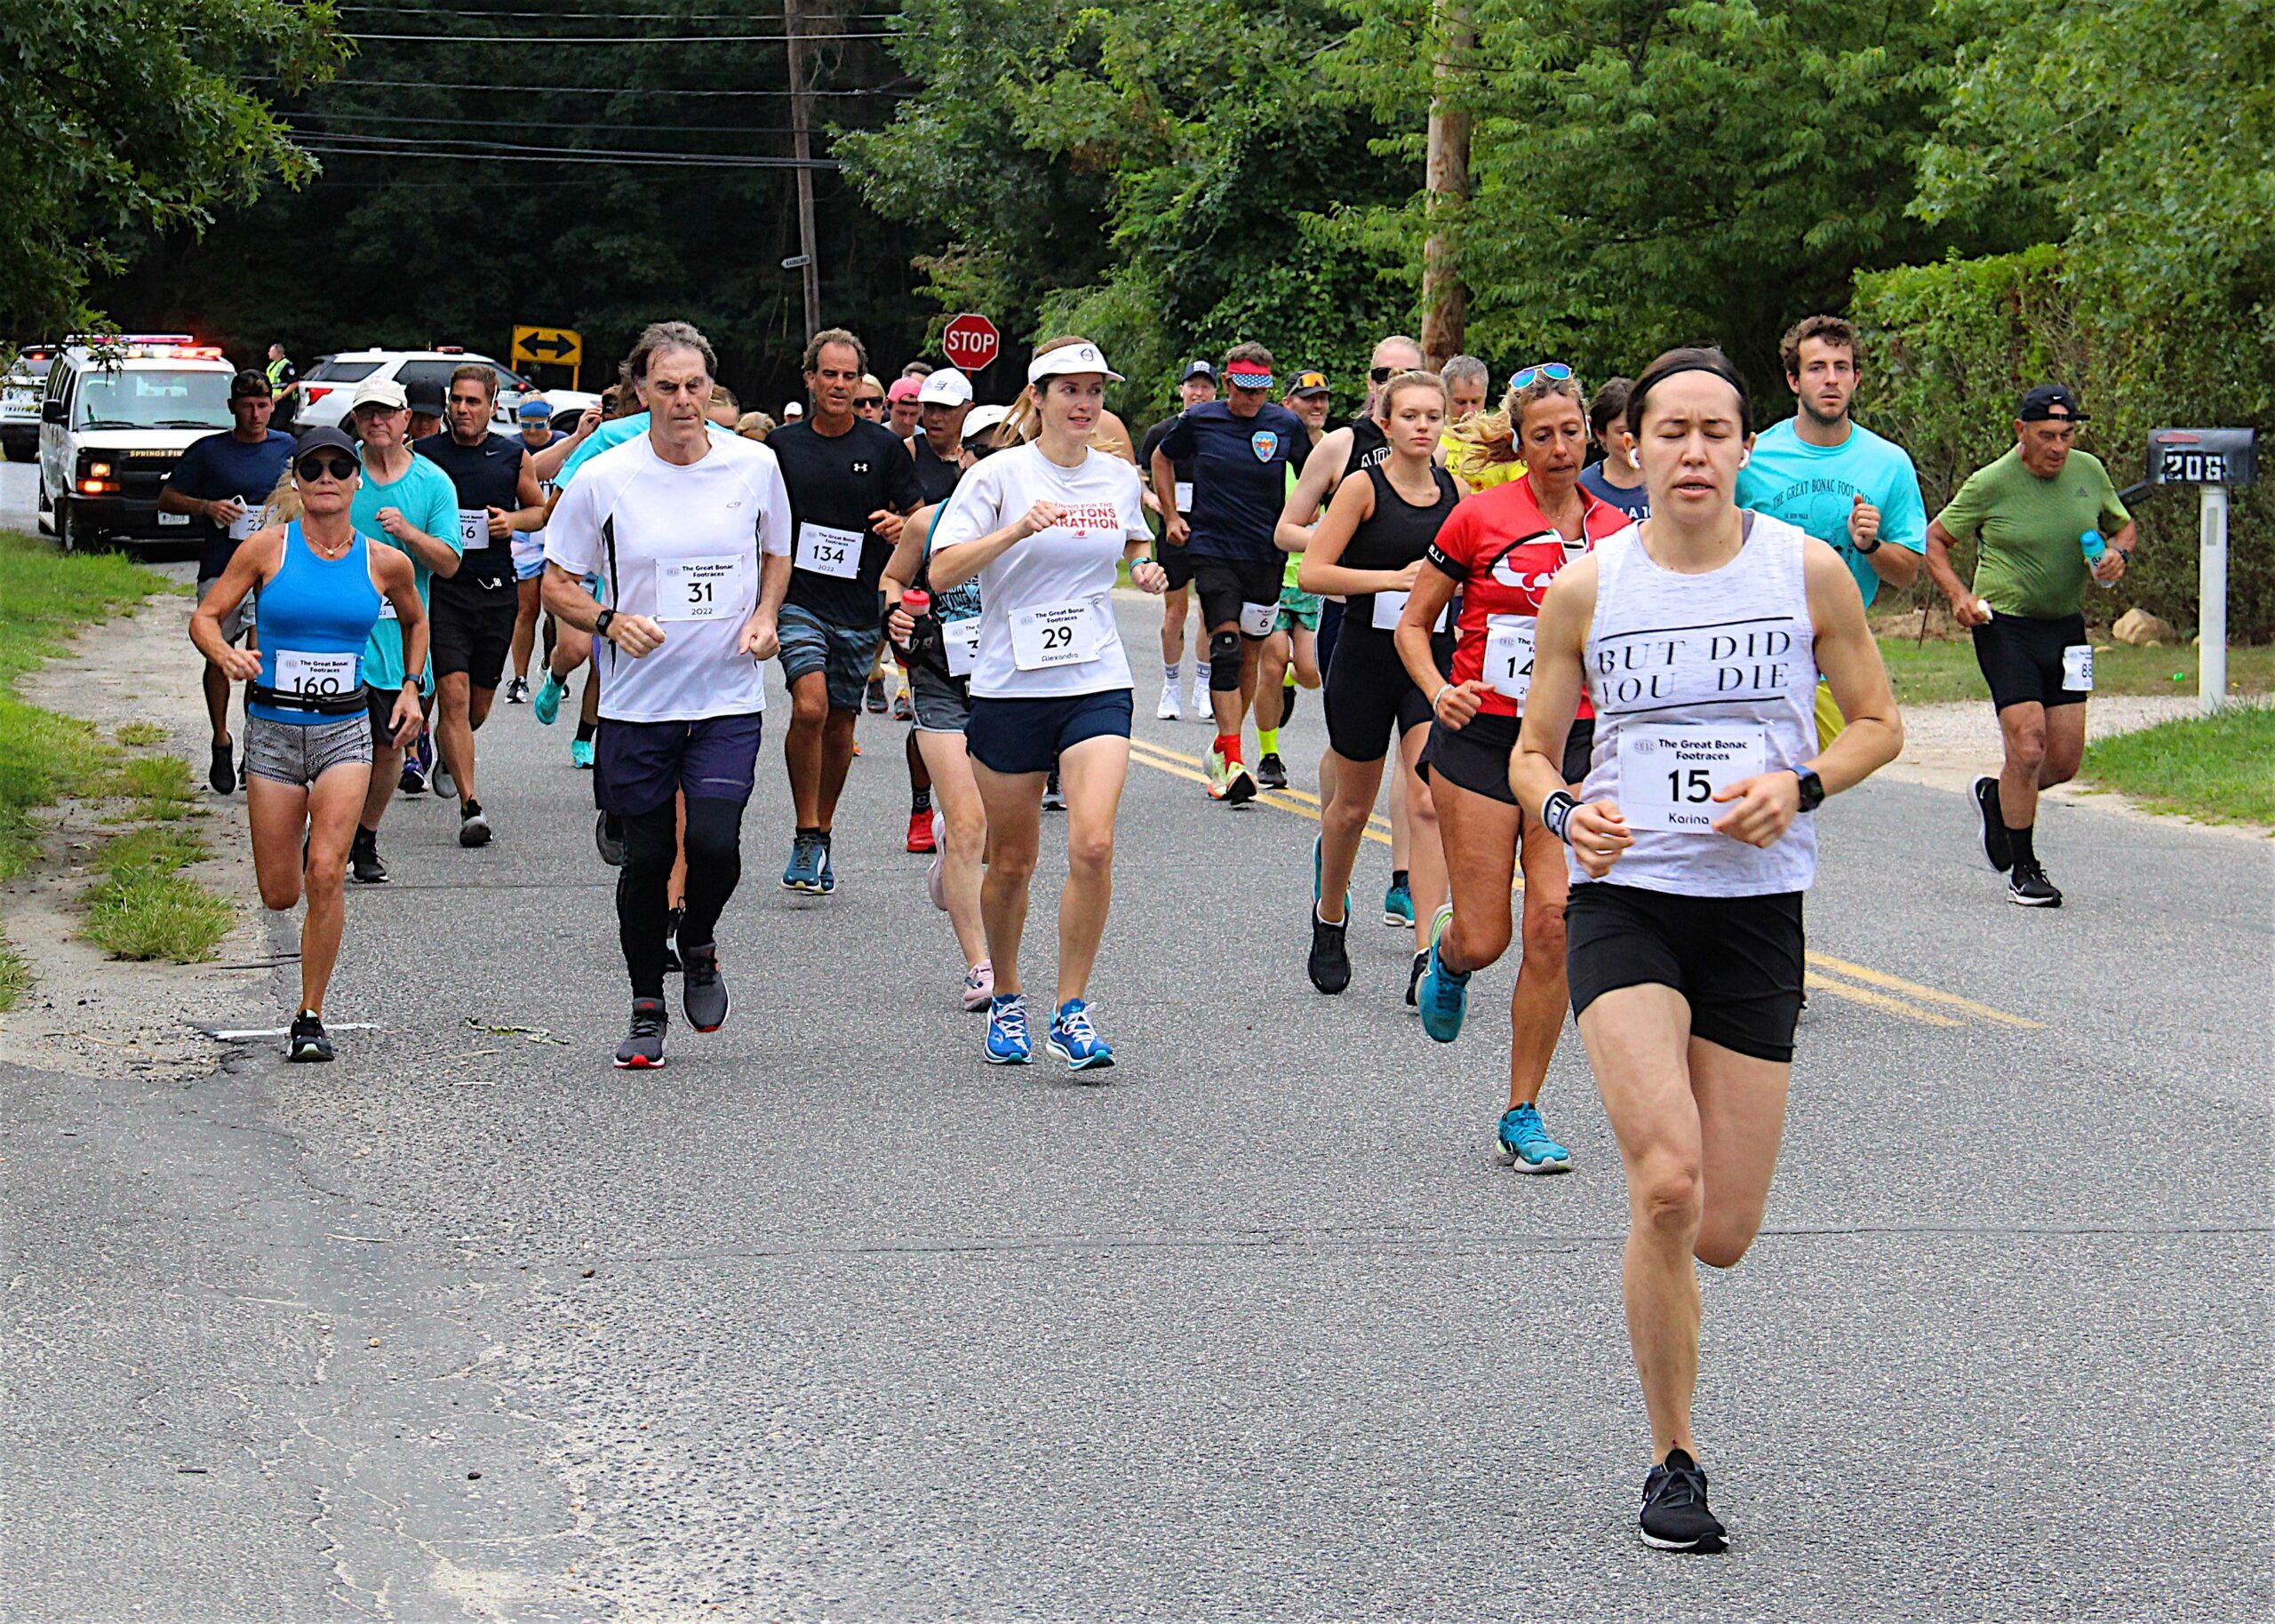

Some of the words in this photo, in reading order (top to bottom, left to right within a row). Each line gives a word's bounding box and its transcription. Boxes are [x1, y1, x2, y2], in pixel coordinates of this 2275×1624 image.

[947, 330, 995, 354] STOP
[2166, 455, 2222, 481] 206
[1772, 490, 1784, 511] THE
[1786, 481, 1809, 501] GREAT
[1811, 479, 1835, 493] BONAC
[1838, 480, 1855, 498] FOOT
[1052, 518, 1119, 530] ARATHON
[813, 545, 844, 564] 134
[687, 582, 713, 603] 31
[1047, 615, 1078, 624] Footraces
[1259, 617, 1269, 628] 6
[1041, 626, 1073, 649] 29
[1518, 637, 1531, 646] The
[1042, 652, 1079, 663] Alexandra
[1598, 640, 1687, 675] BUT
[1710, 630, 1792, 661] DID
[293, 676, 339, 695] 160
[1601, 673, 1676, 705] YOU
[1717, 662, 1790, 692] DIE
[1658, 738, 1677, 749] The
[1680, 739, 1712, 749] Great
[1715, 740, 1748, 750] Bonac
[1676, 751, 1730, 760] Footraces
[1668, 768, 1712, 803] 15
[1668, 812, 1710, 825] Karina
